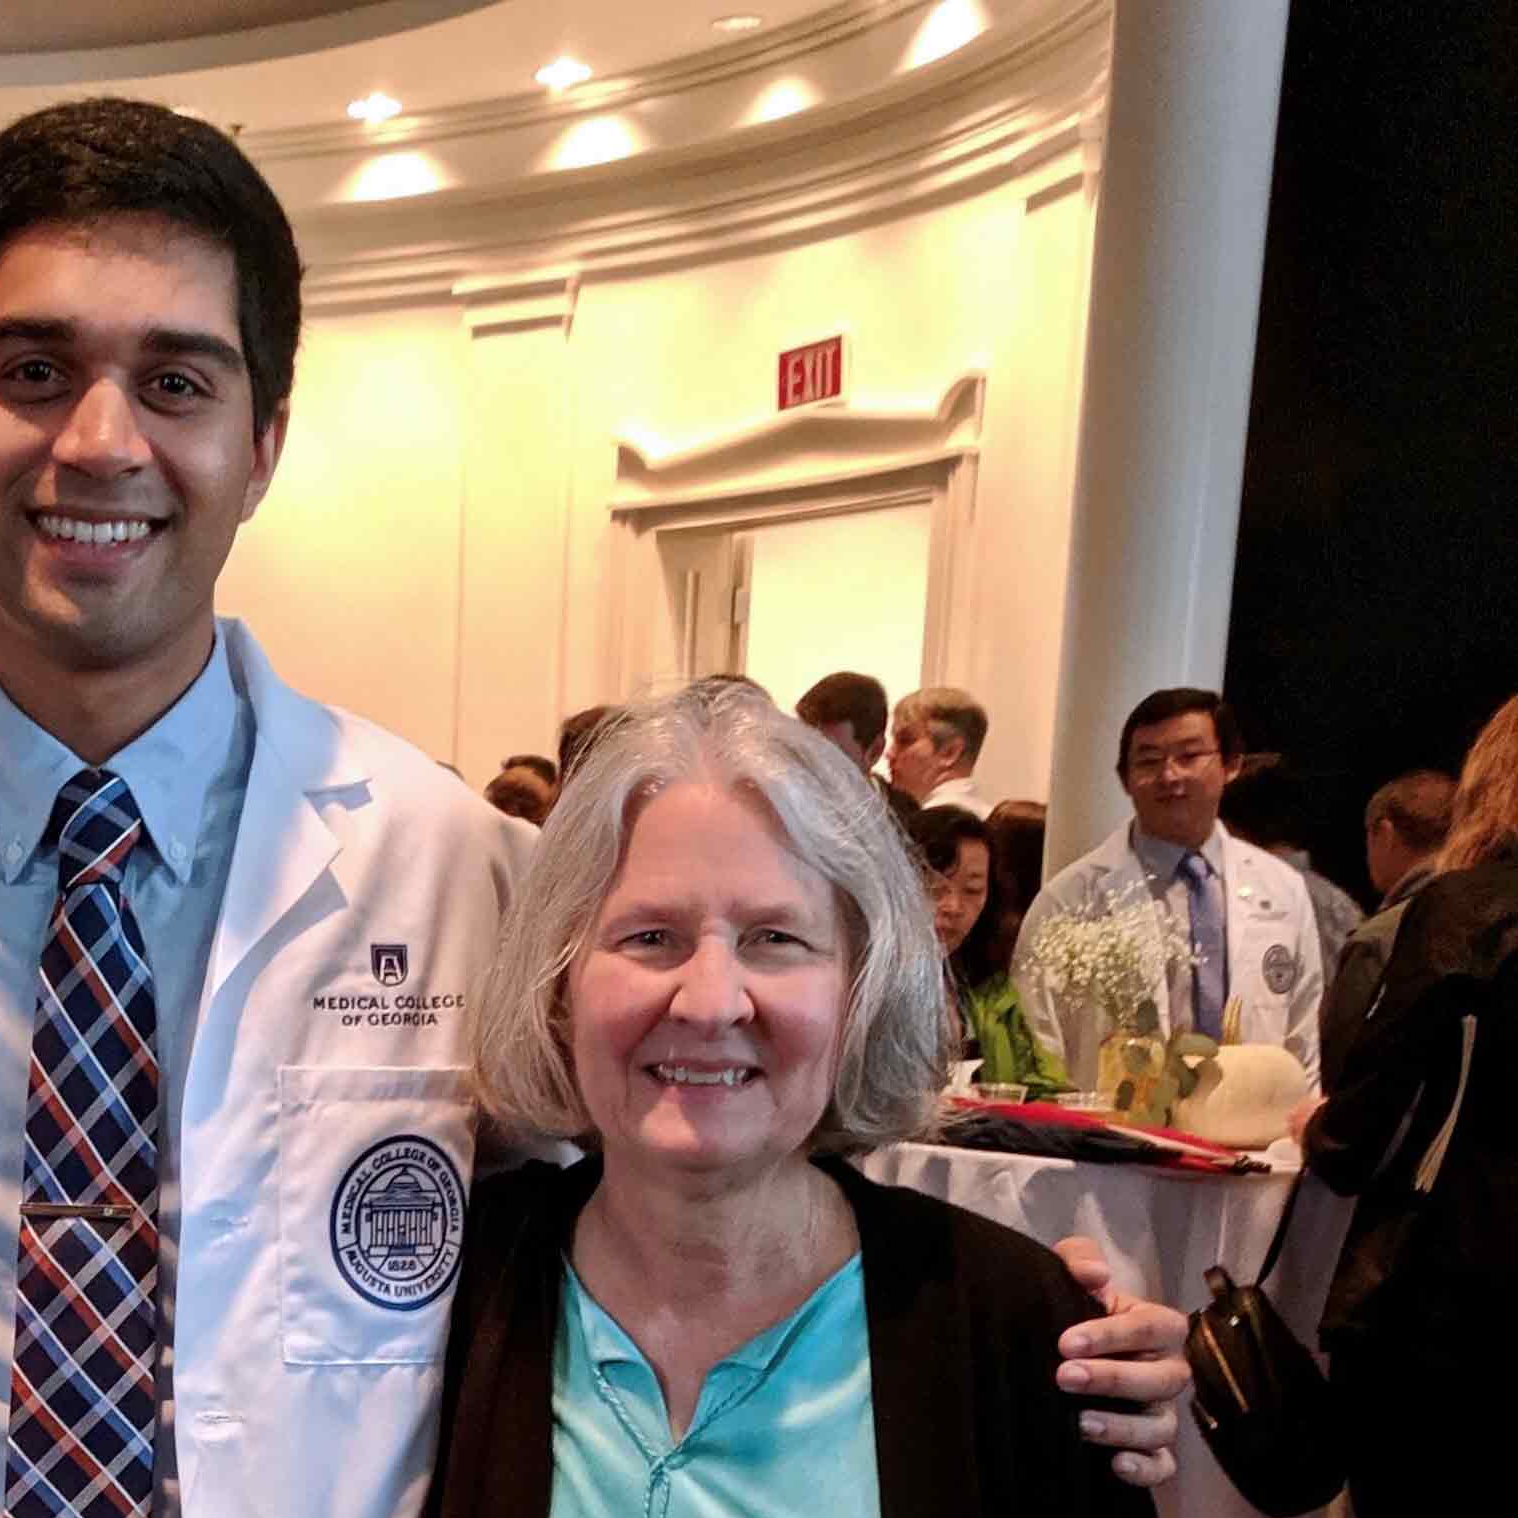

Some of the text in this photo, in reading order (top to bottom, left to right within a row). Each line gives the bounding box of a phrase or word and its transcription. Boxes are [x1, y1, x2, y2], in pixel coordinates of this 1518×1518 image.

[786, 343, 837, 404] EXIT
[313, 994, 465, 1010] MEDICAL COLLEGE
[341, 1013, 438, 1027] OF GEORGIA
[341, 1147, 459, 1234] MEDICAL COLLEGE OF GEORGIA
[346, 1248, 454, 1297] AUGUSTA UNIVERSITY
[388, 1260, 417, 1272] 1828
